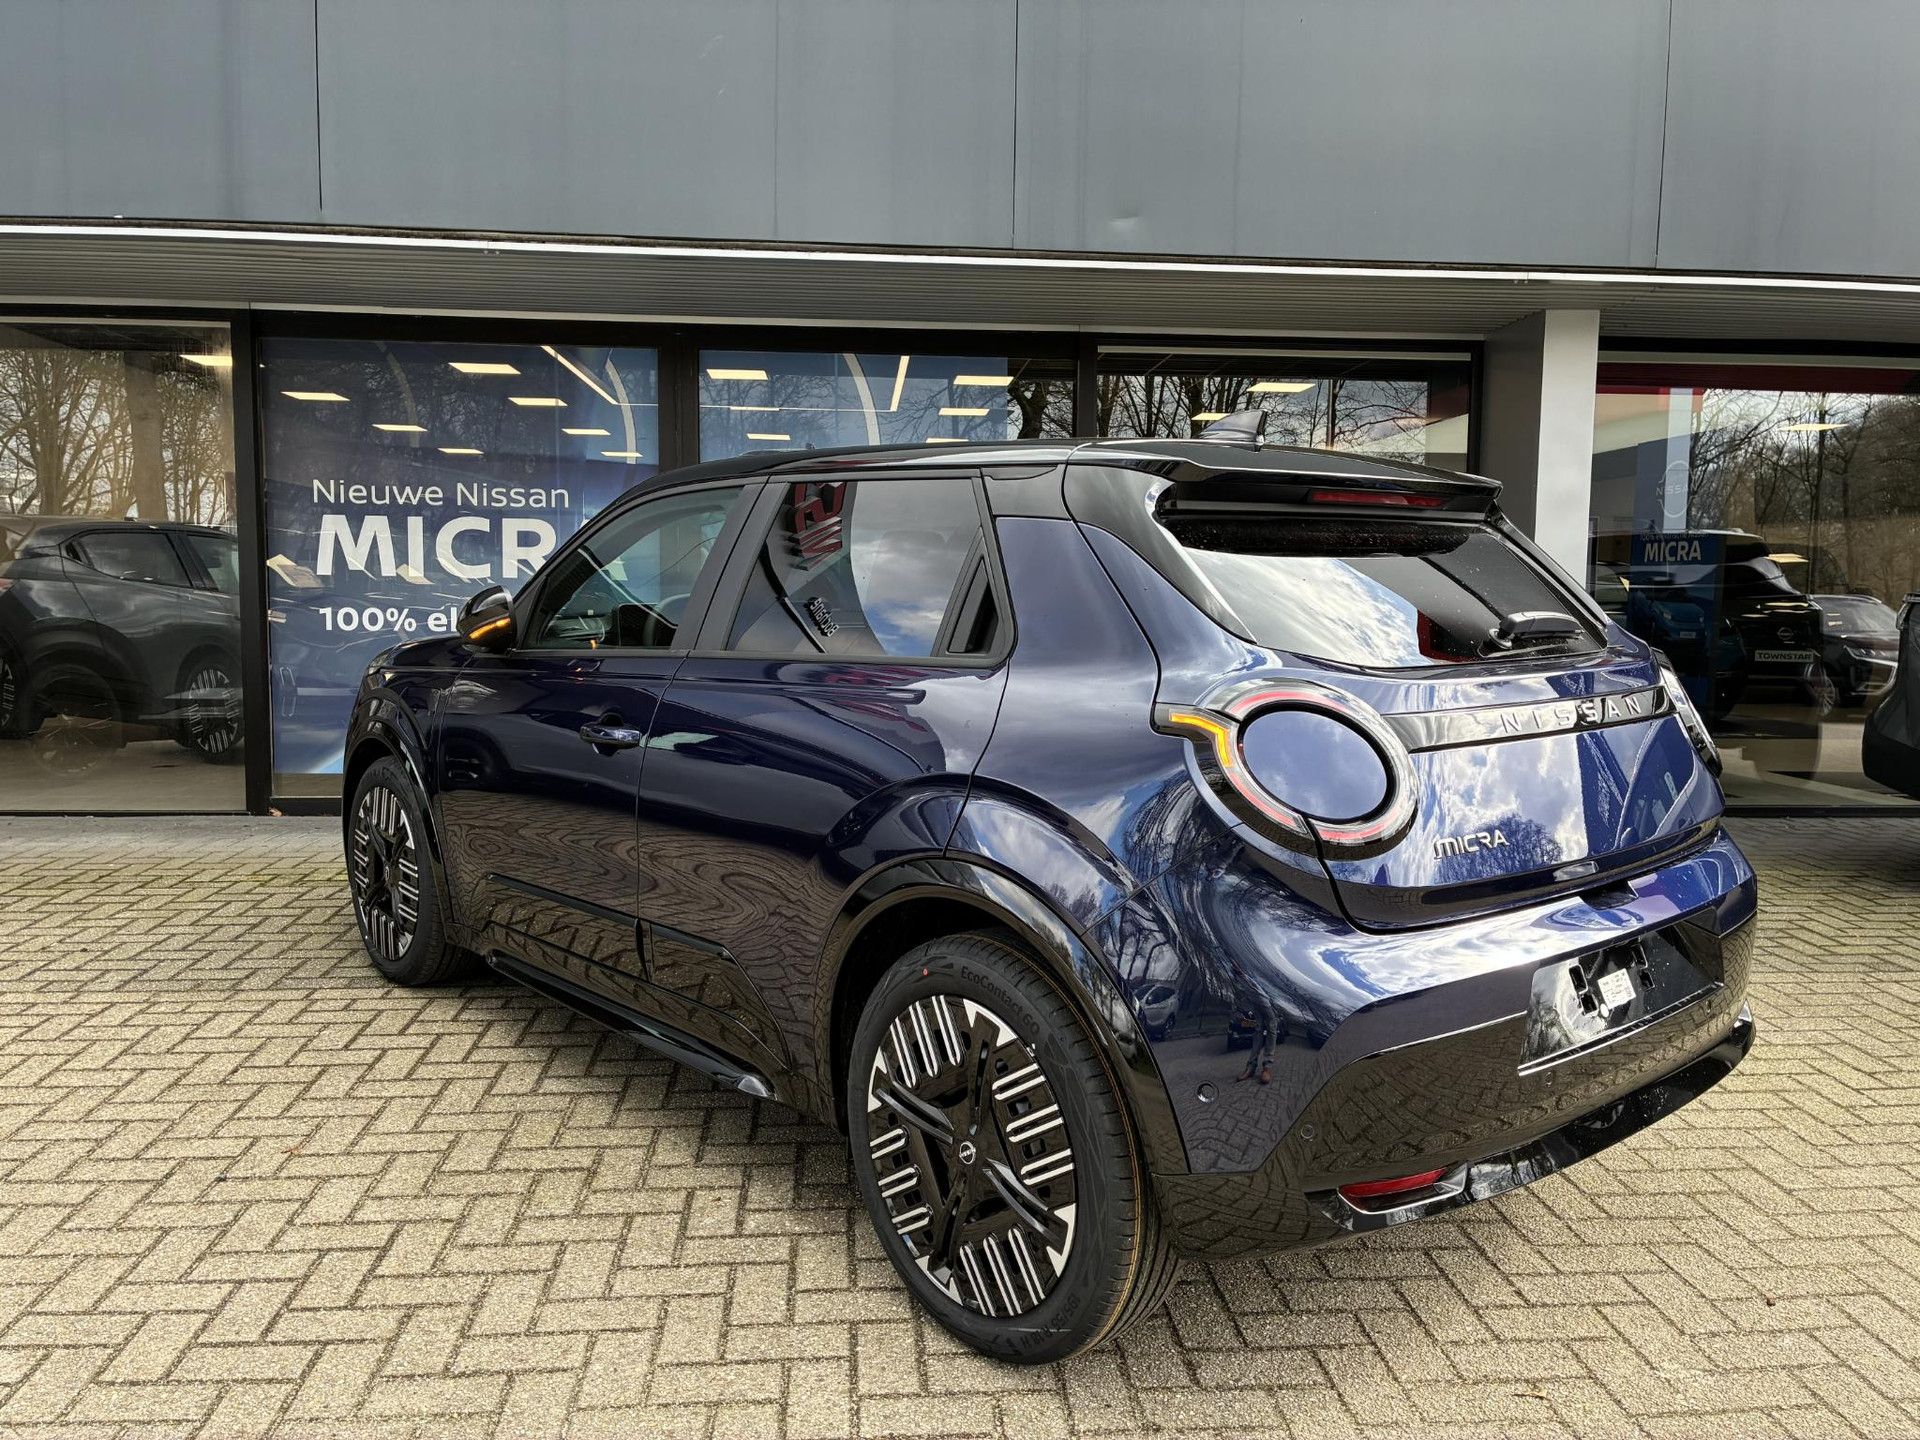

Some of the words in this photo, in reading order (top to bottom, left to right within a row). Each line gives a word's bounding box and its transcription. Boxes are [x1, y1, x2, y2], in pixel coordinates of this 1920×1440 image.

[312, 478, 444, 506] Nieuwe
[456, 482, 570, 509] Nissan
[315, 513, 592, 580] MICR
[1644, 540, 1702, 563] MICRA
[319, 607, 416, 632] 100%
[427, 606, 458, 633] el
[1756, 651, 1813, 661] TOWNSTAR
[1500, 696, 1643, 734] NISSAN
[1432, 829, 1510, 862] MICRA
[960, 965, 1024, 1017] EcoContact
